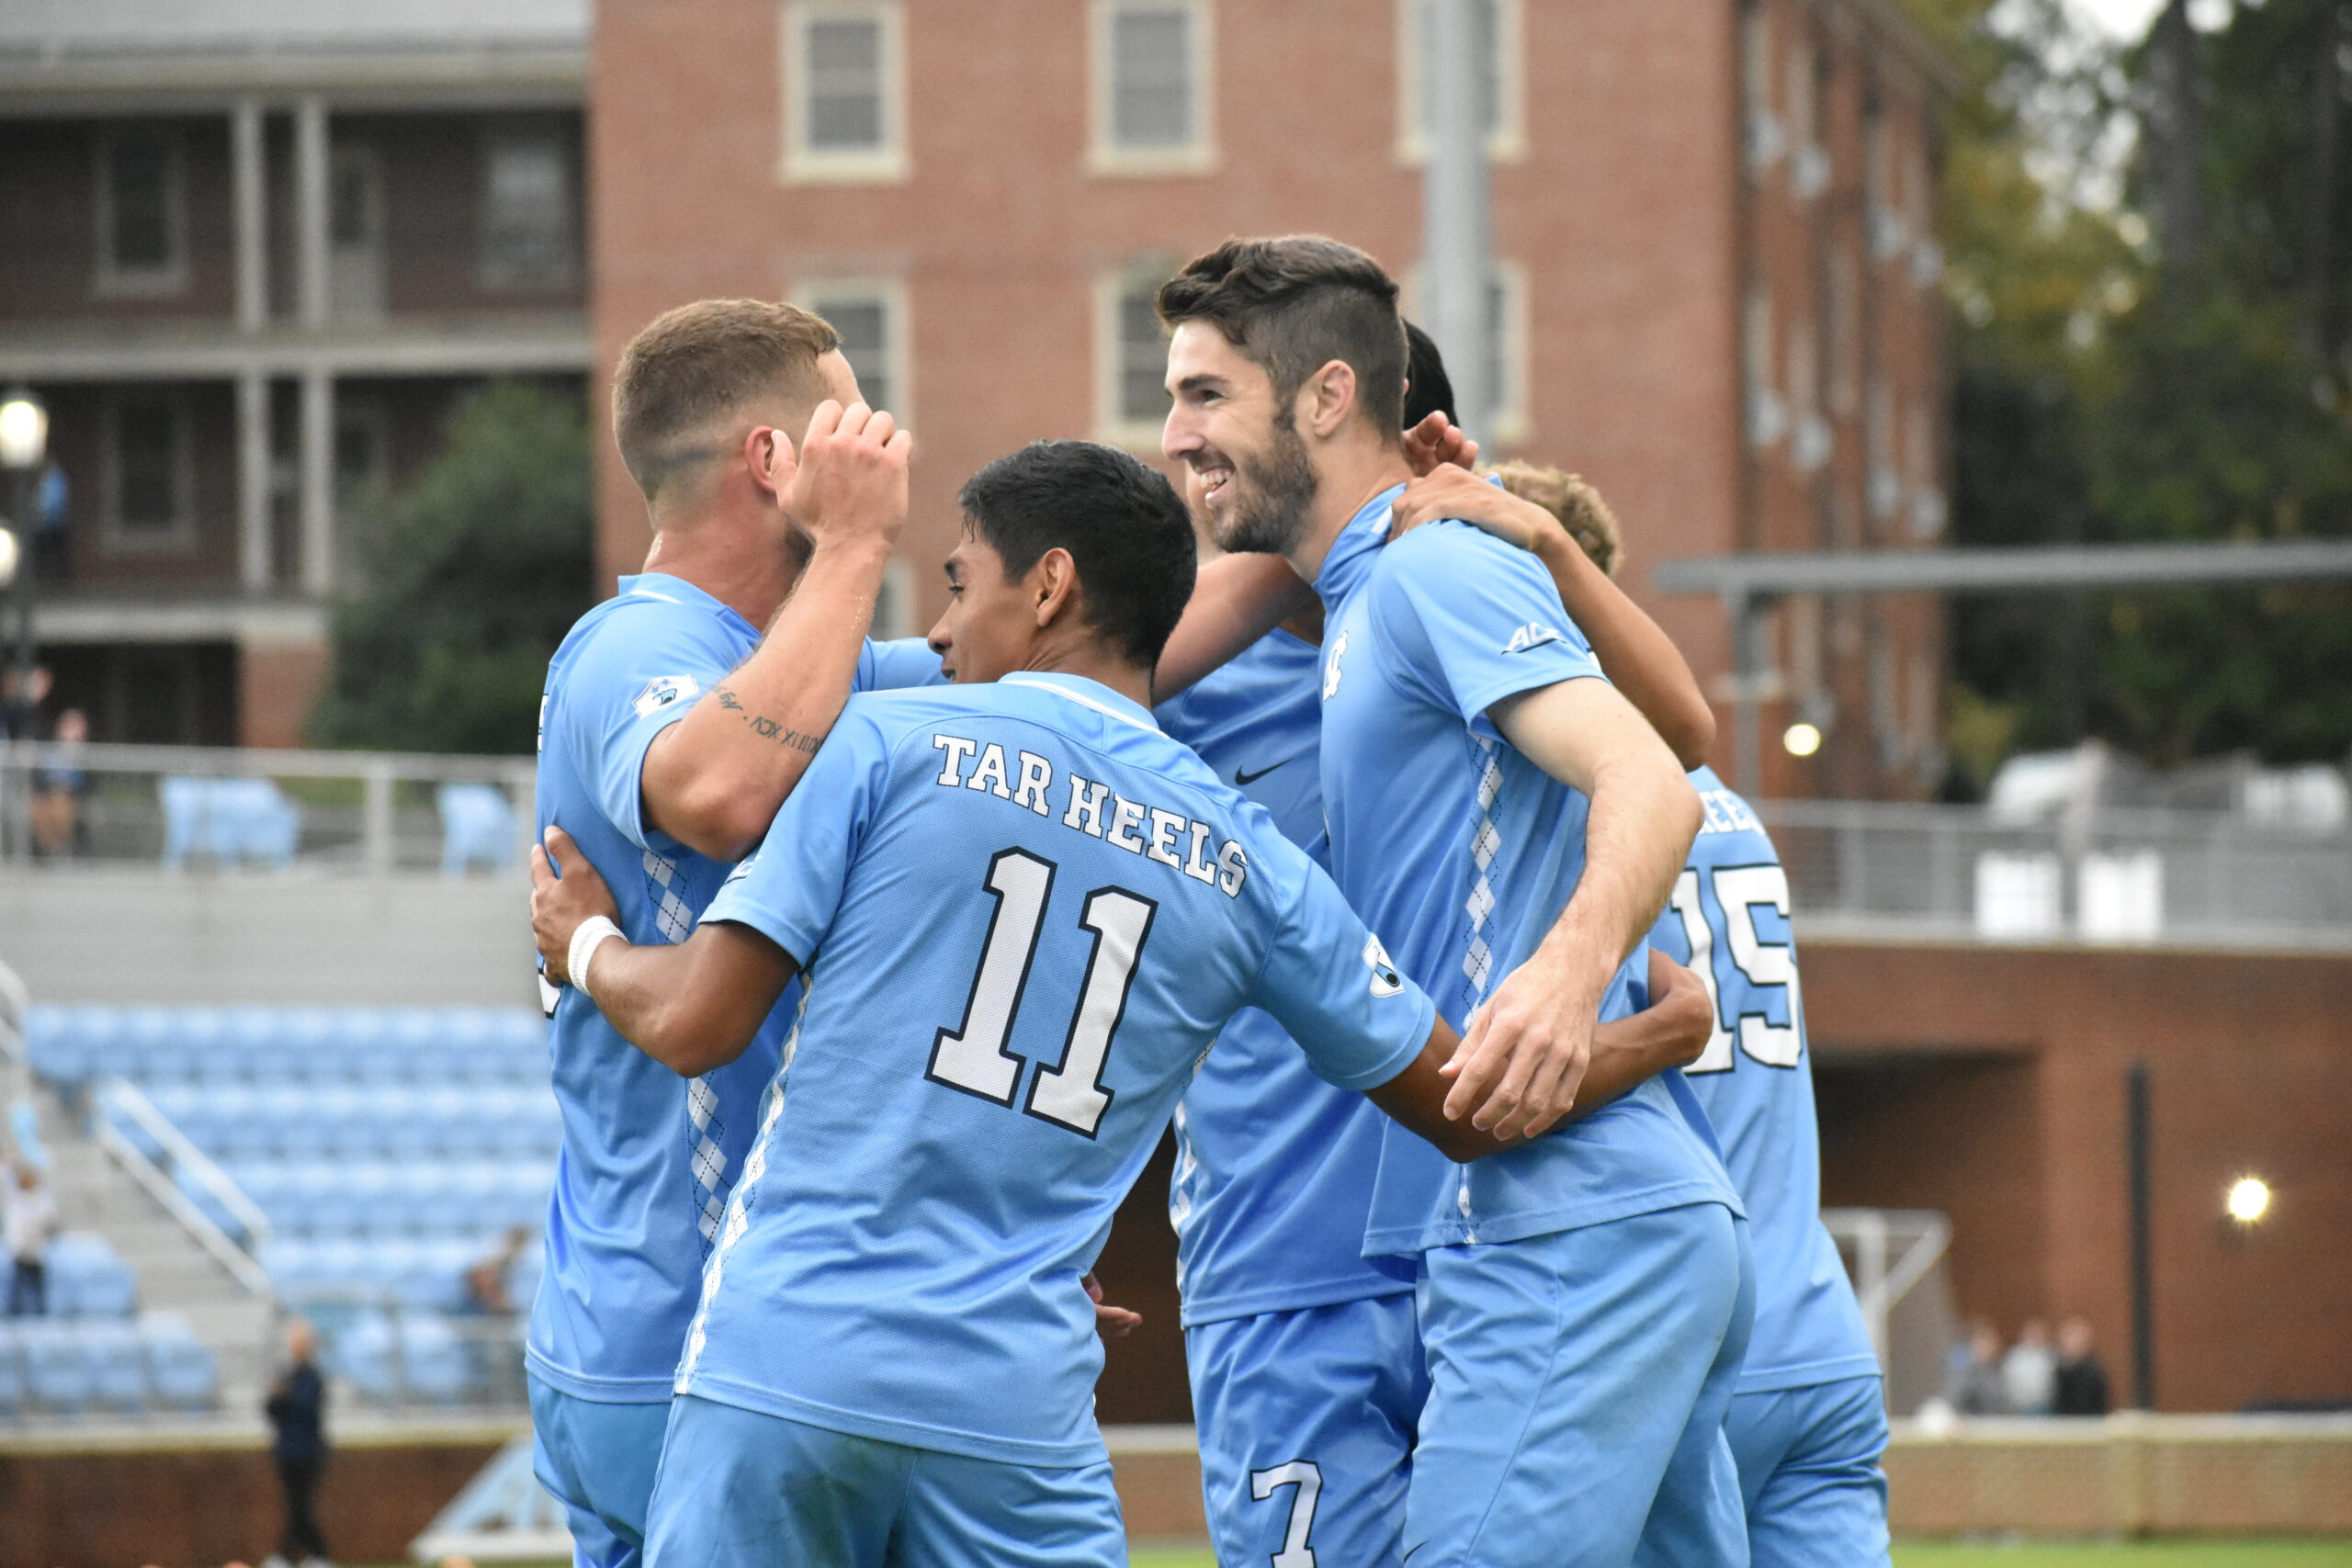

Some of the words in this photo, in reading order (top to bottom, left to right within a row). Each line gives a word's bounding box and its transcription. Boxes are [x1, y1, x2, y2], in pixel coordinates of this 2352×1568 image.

[933, 734, 1053, 817] TAR
[1062, 772, 1248, 898] HEELS
[924, 845, 1159, 1141] 11
[1670, 862, 1803, 1076] 15
[1250, 1459, 1323, 1568] 7
